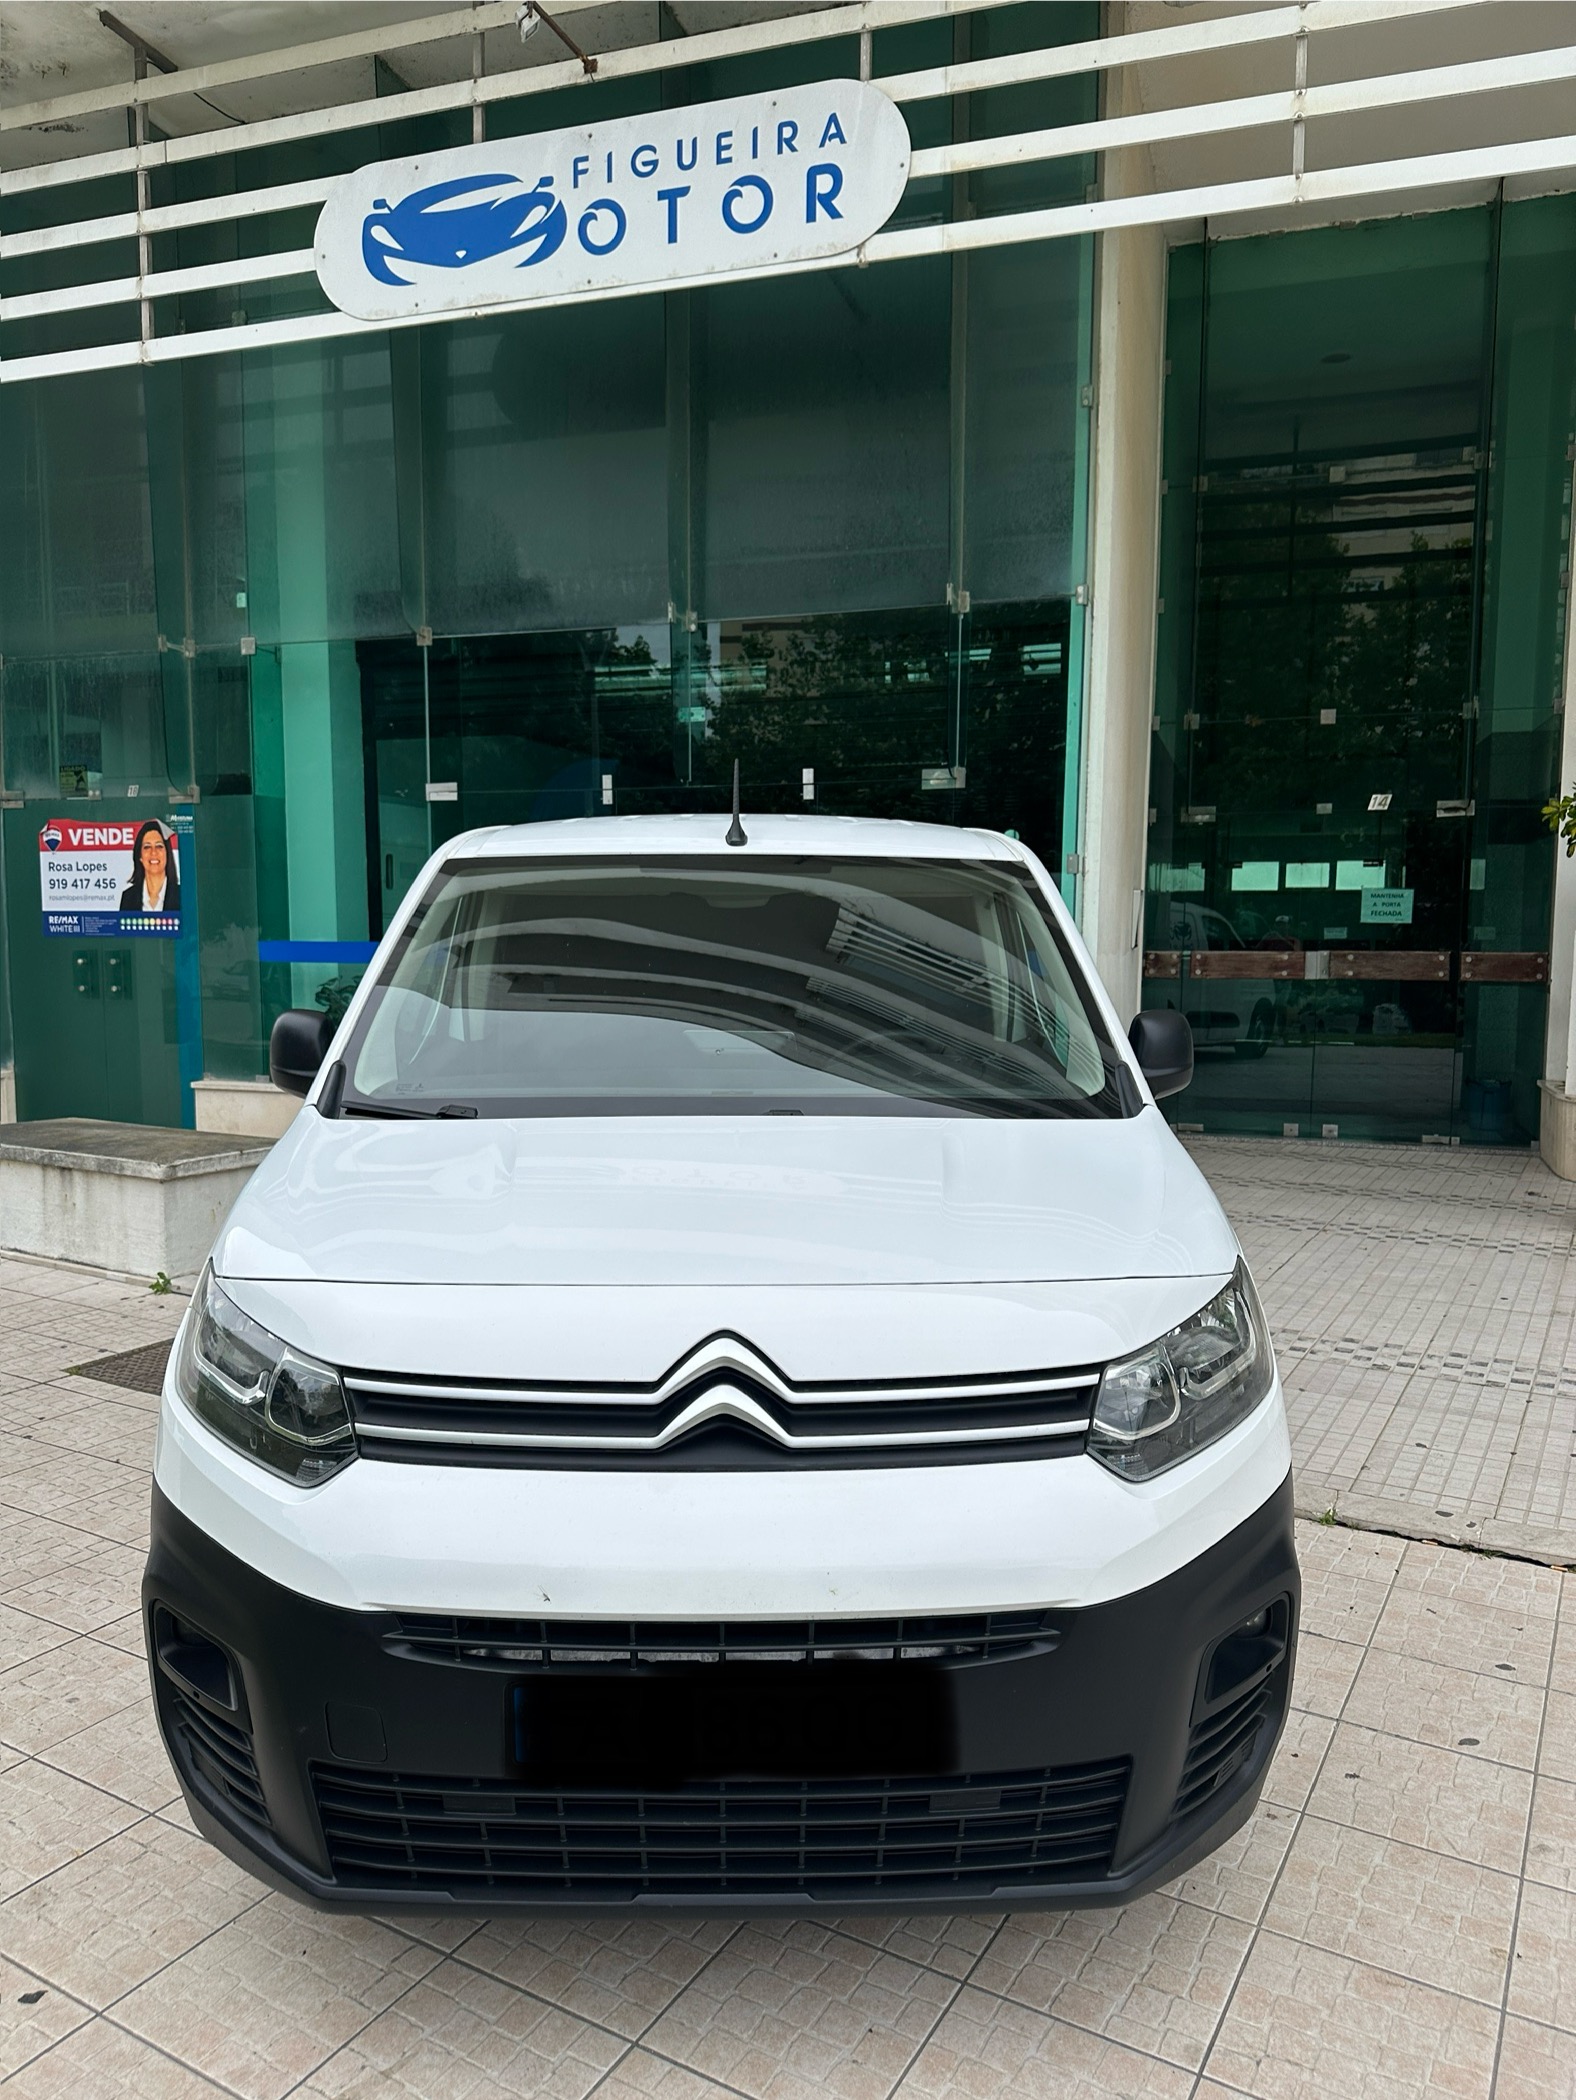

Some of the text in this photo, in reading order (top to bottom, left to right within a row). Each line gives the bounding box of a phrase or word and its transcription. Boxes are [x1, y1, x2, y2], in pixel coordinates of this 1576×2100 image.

[573, 112, 847, 188] FIGUEIRA
[1371, 796, 1389, 809] 14
[68, 827, 135, 846] VENDE
[48, 861, 108, 873] Rosa Lopes
[49, 878, 117, 890] 919 417 456
[48, 915, 79, 924] RE/MAX
